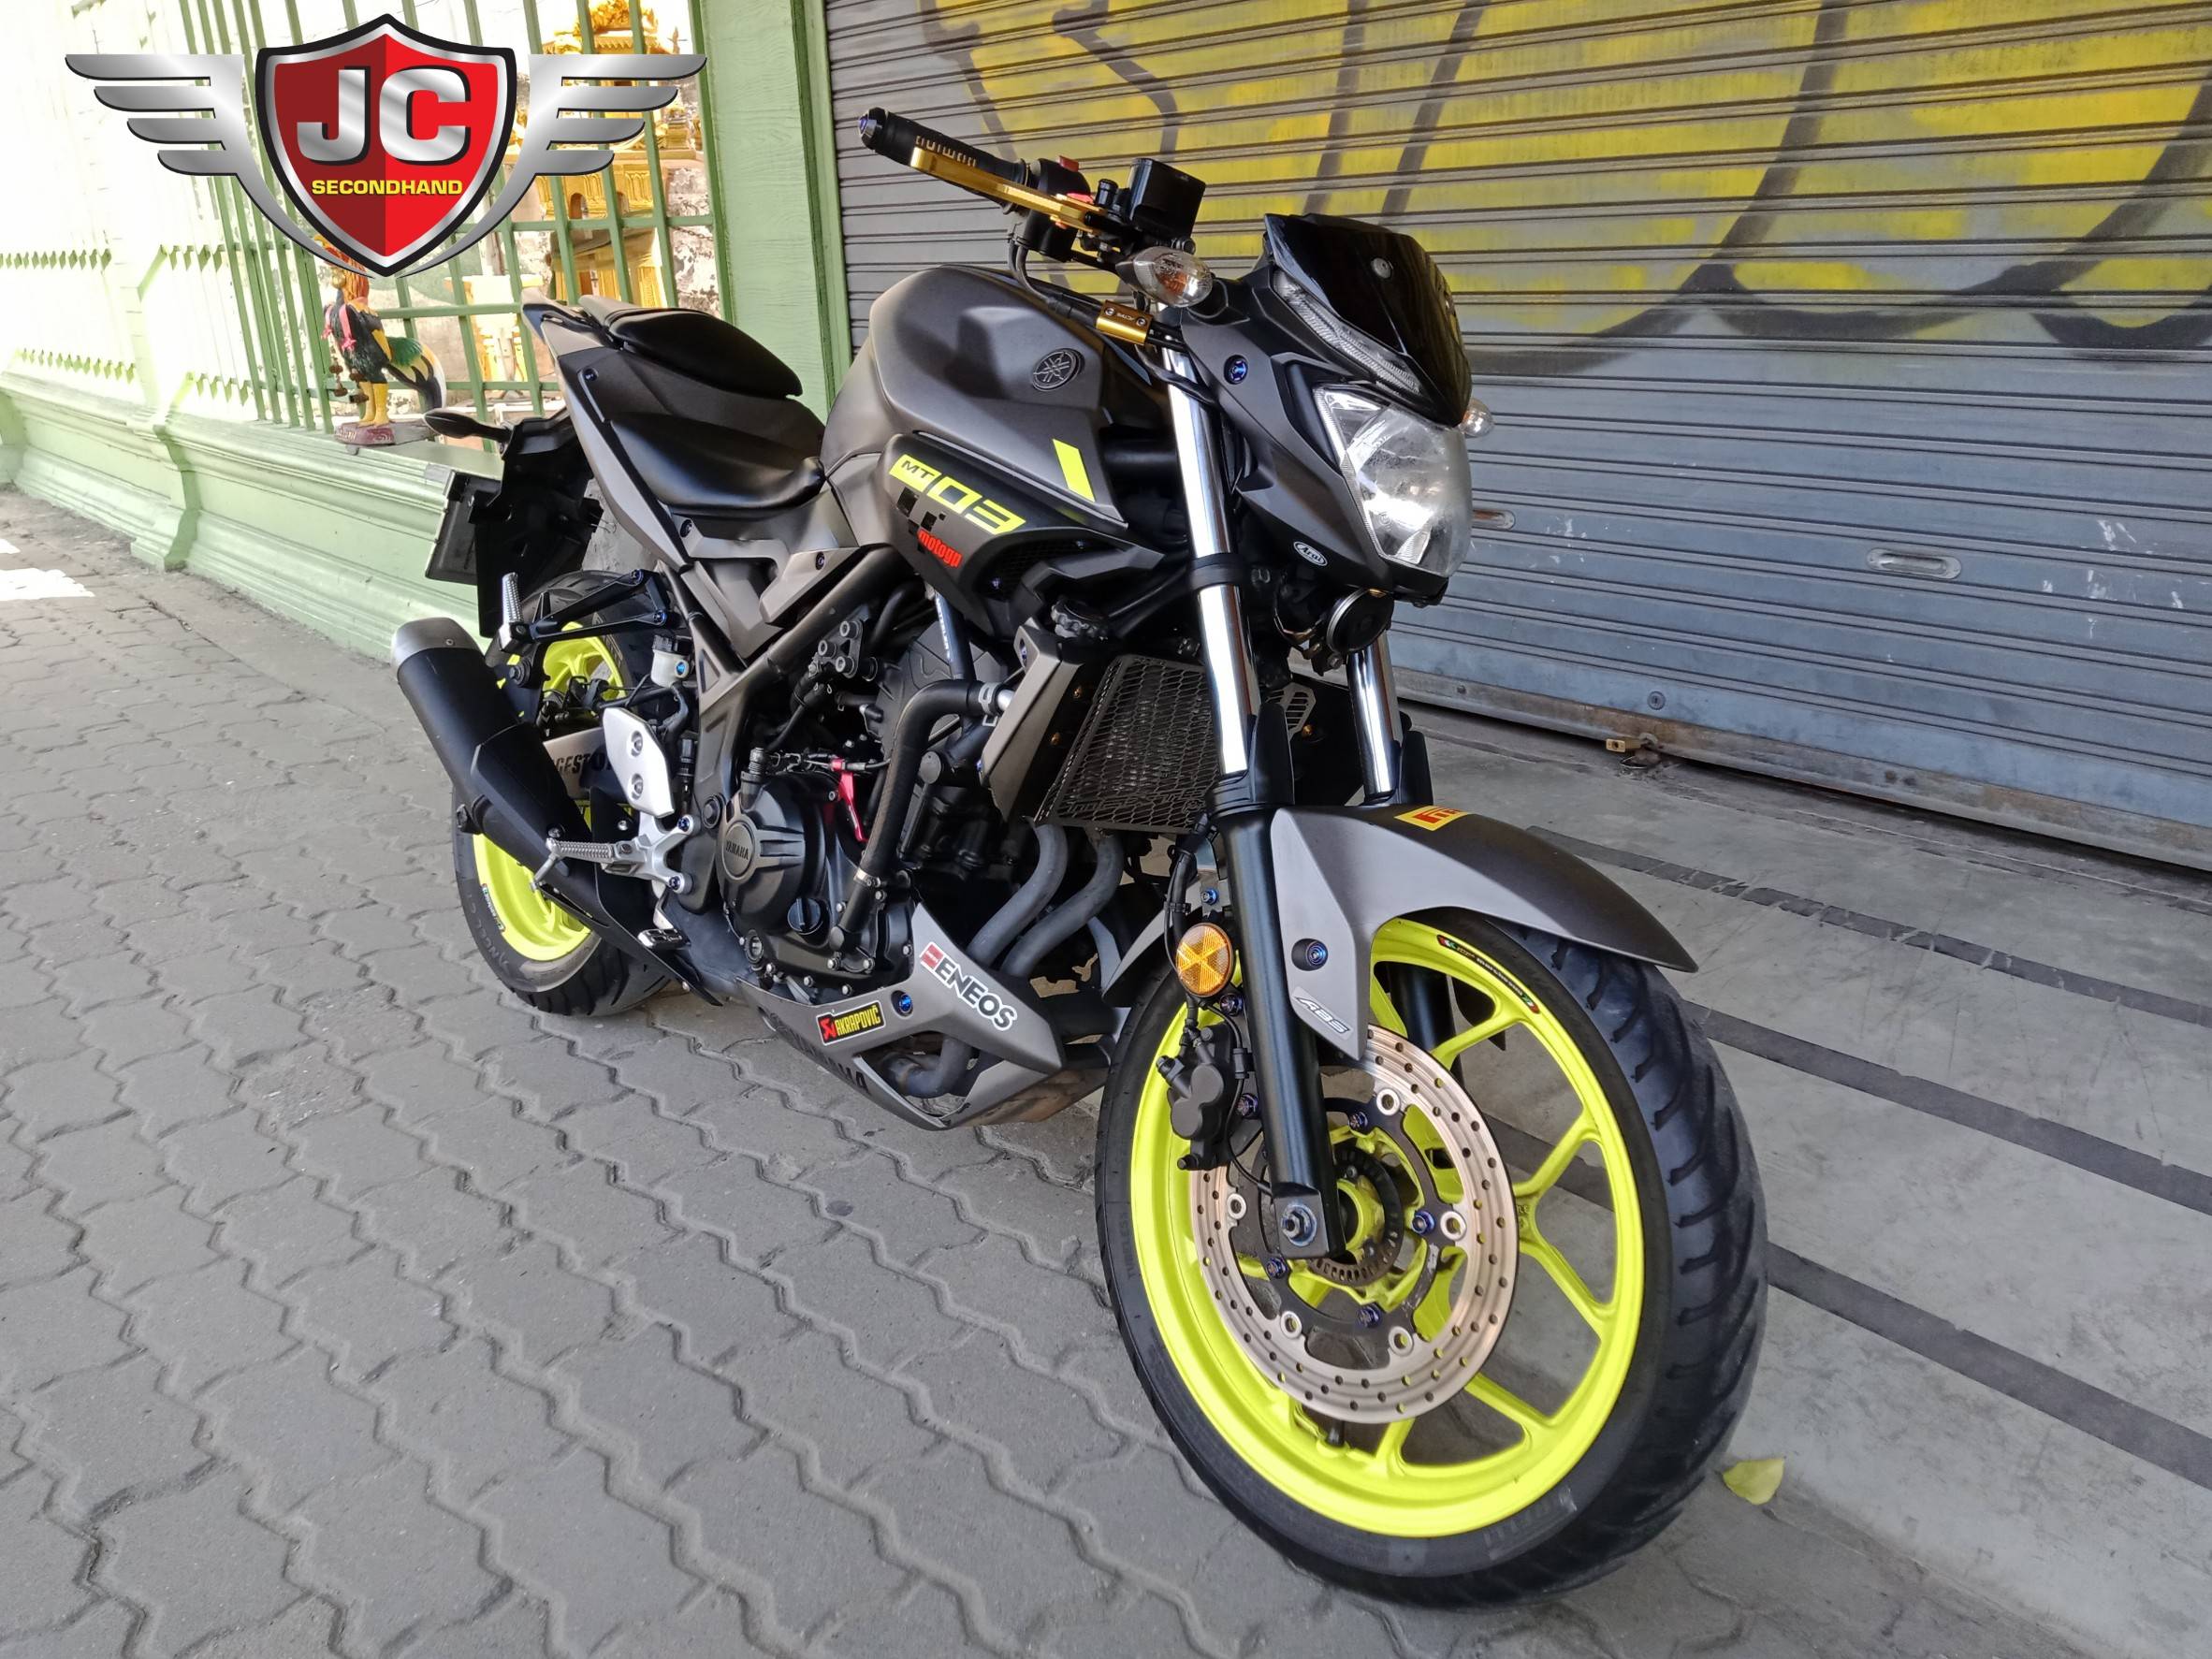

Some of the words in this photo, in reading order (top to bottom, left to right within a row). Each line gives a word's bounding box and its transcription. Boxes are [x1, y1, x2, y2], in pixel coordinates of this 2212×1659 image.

[901, 460, 935, 480] MT
[926, 475, 1026, 535] 03
[726, 840, 749, 860] YAMAHA
[934, 955, 1016, 1029] ENEOS
[835, 1004, 881, 1036] AKRAPOVIČ
[1295, 997, 1349, 1034] ABS
